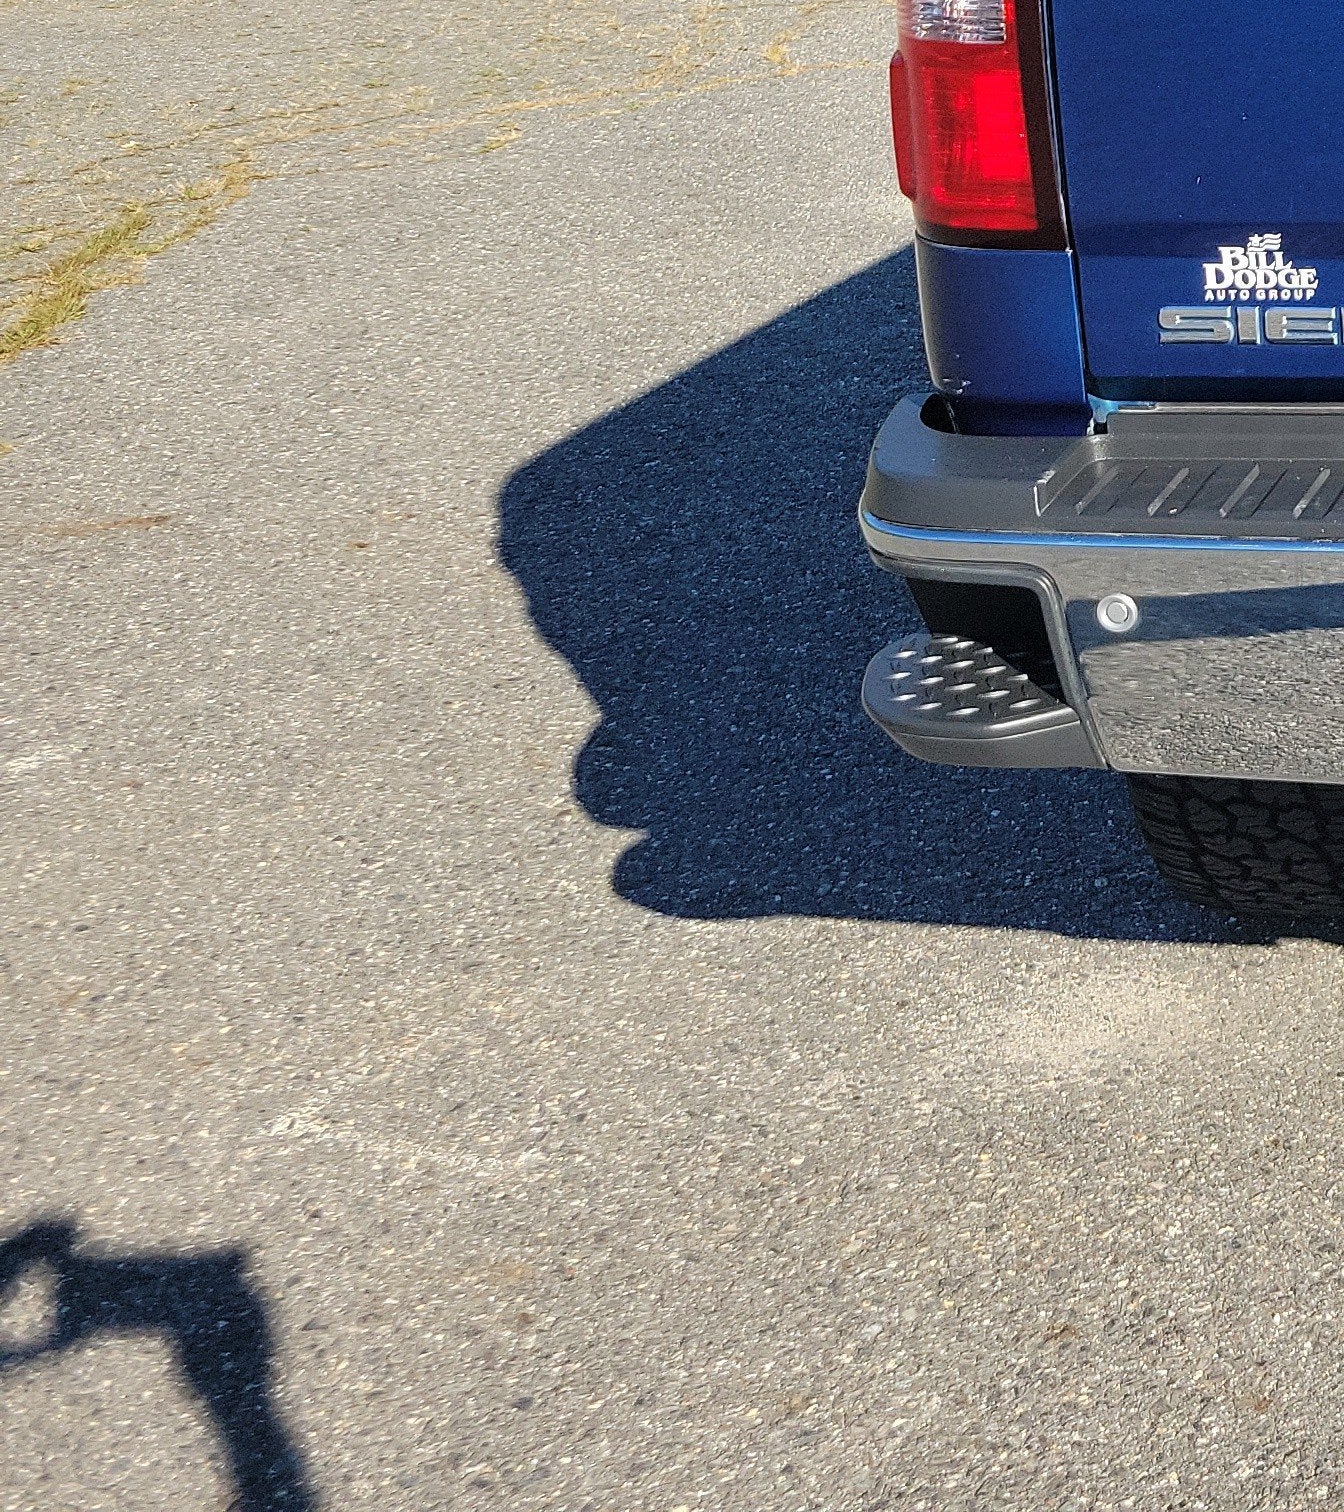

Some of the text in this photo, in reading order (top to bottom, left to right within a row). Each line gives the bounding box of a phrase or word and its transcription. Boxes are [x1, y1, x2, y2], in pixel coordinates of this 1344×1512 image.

[1218, 246, 1293, 271] BILL
[1203, 263, 1318, 290] DODGE
[1204, 289, 1315, 301] AUTO GROUP
